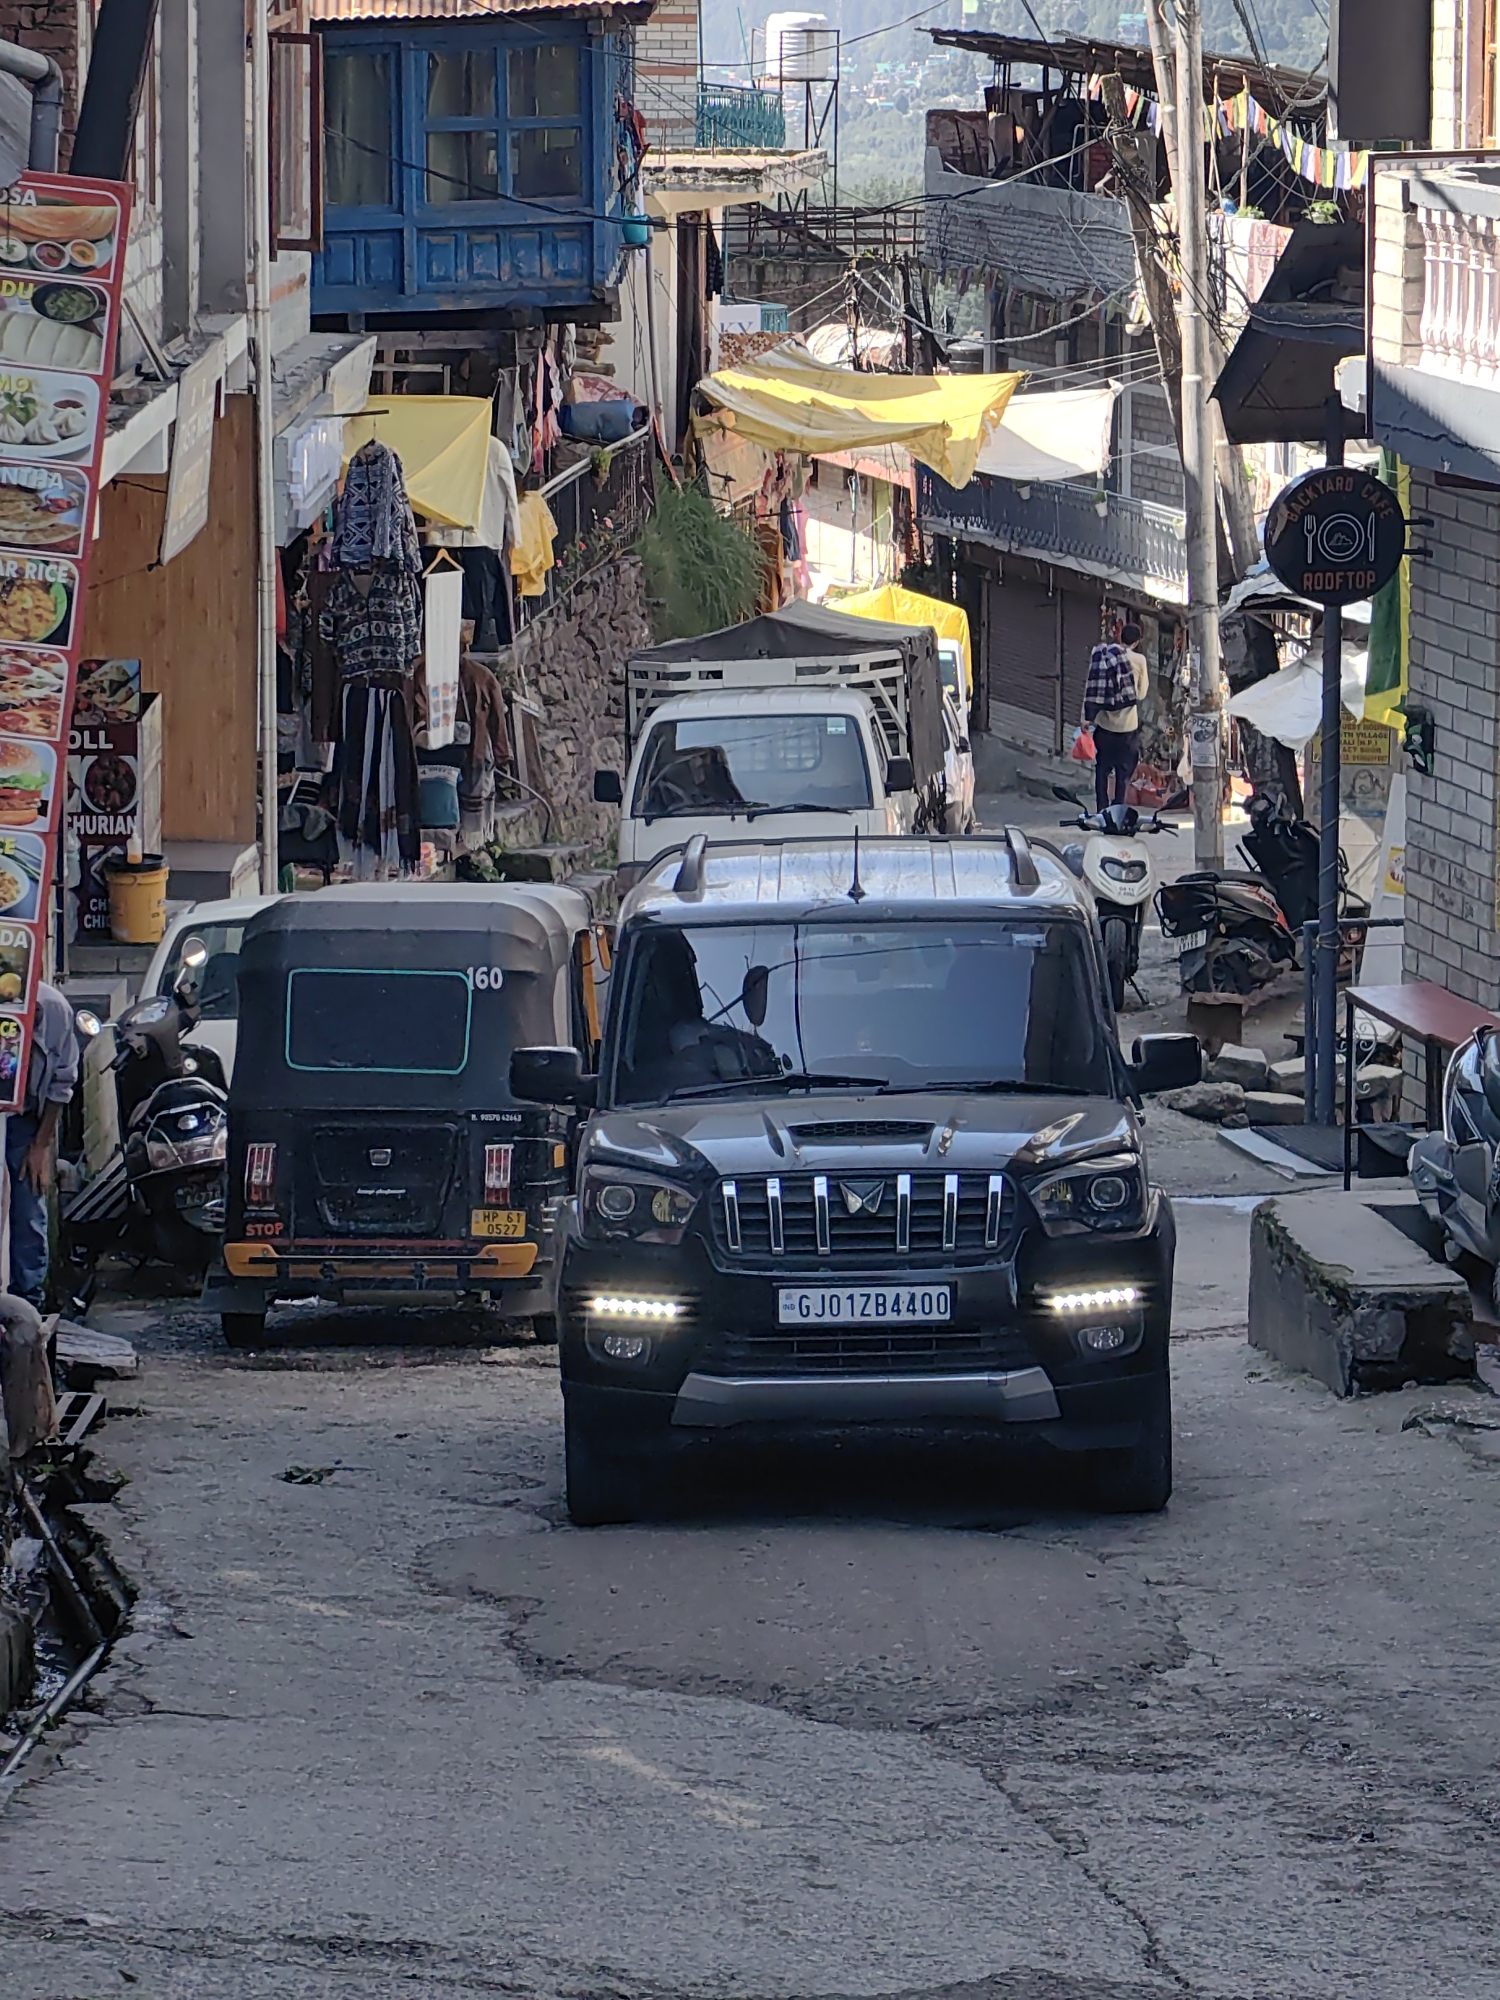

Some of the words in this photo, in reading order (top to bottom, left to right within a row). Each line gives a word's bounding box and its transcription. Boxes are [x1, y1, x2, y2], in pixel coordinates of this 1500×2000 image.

[1287, 476, 1354, 522] BACKYARD
[1360, 482, 1394, 519] CAFE
[25, 561, 68, 583] RICE
[467, 966, 503, 990] 160
[483, 1211, 499, 1222] HP
[245, 1222, 284, 1237] STOP
[487, 1223, 518, 1235] 0527
[798, 1291, 949, 1318] GJ01ZB4400
